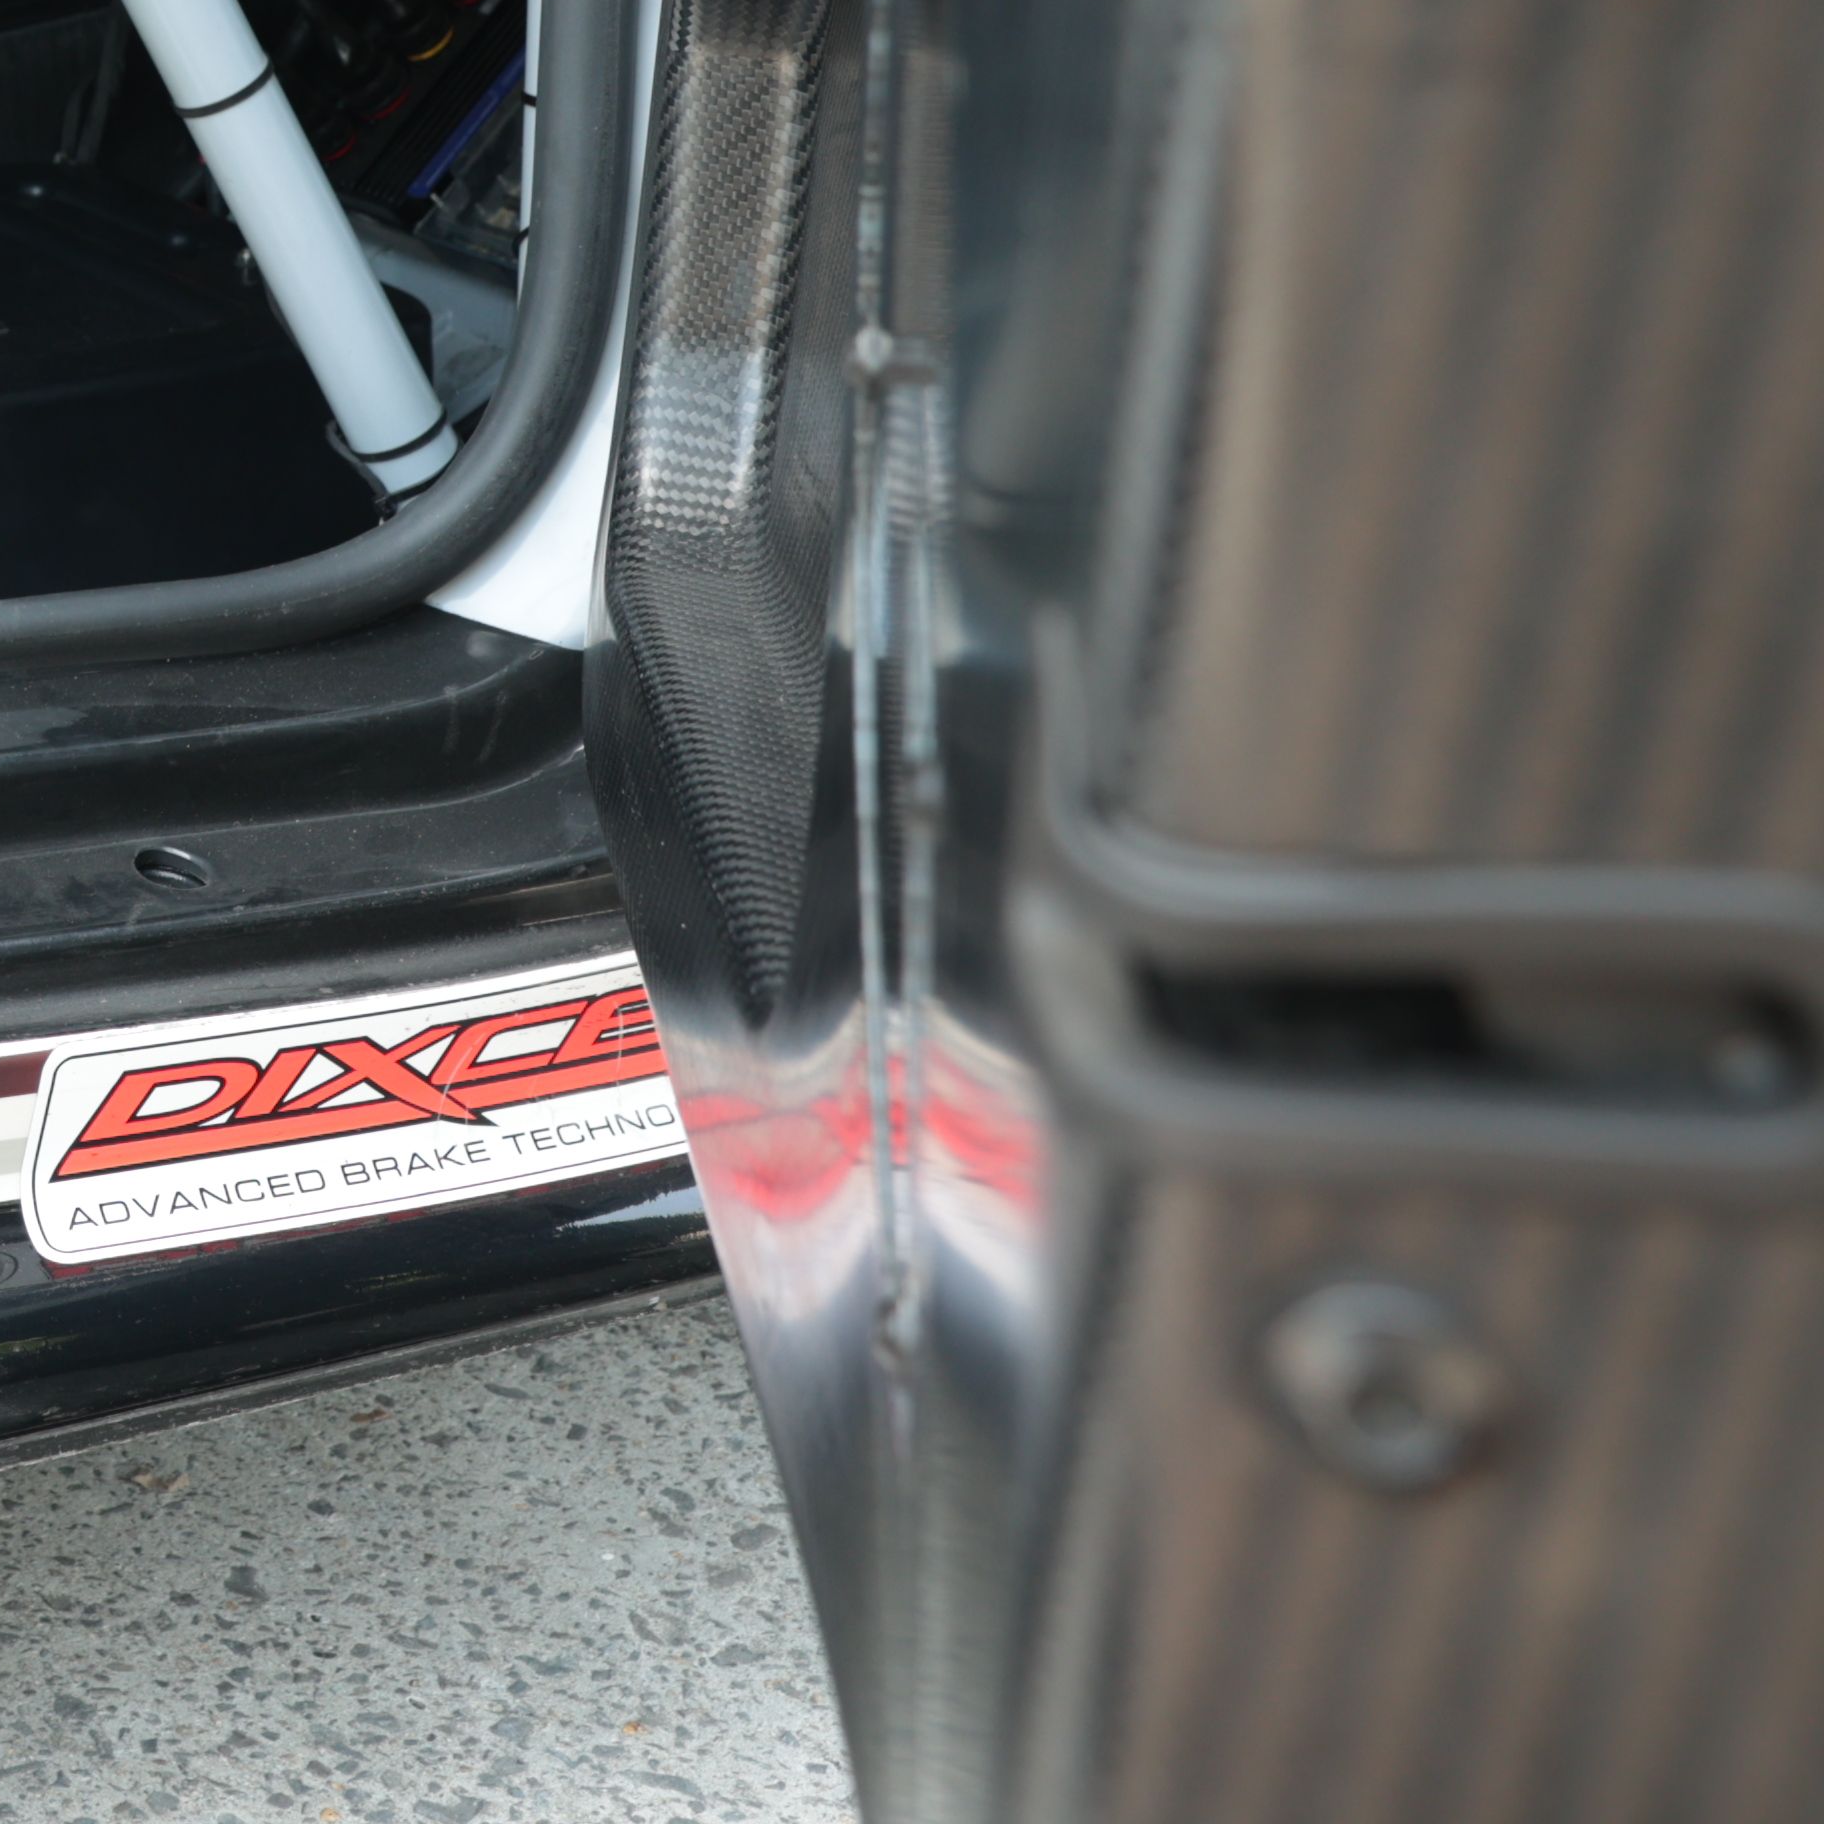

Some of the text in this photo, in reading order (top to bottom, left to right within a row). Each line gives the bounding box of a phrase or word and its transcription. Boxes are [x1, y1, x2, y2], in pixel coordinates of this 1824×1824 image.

[68, 1103, 676, 1231] ADVANCED BRAKE TECHNO
